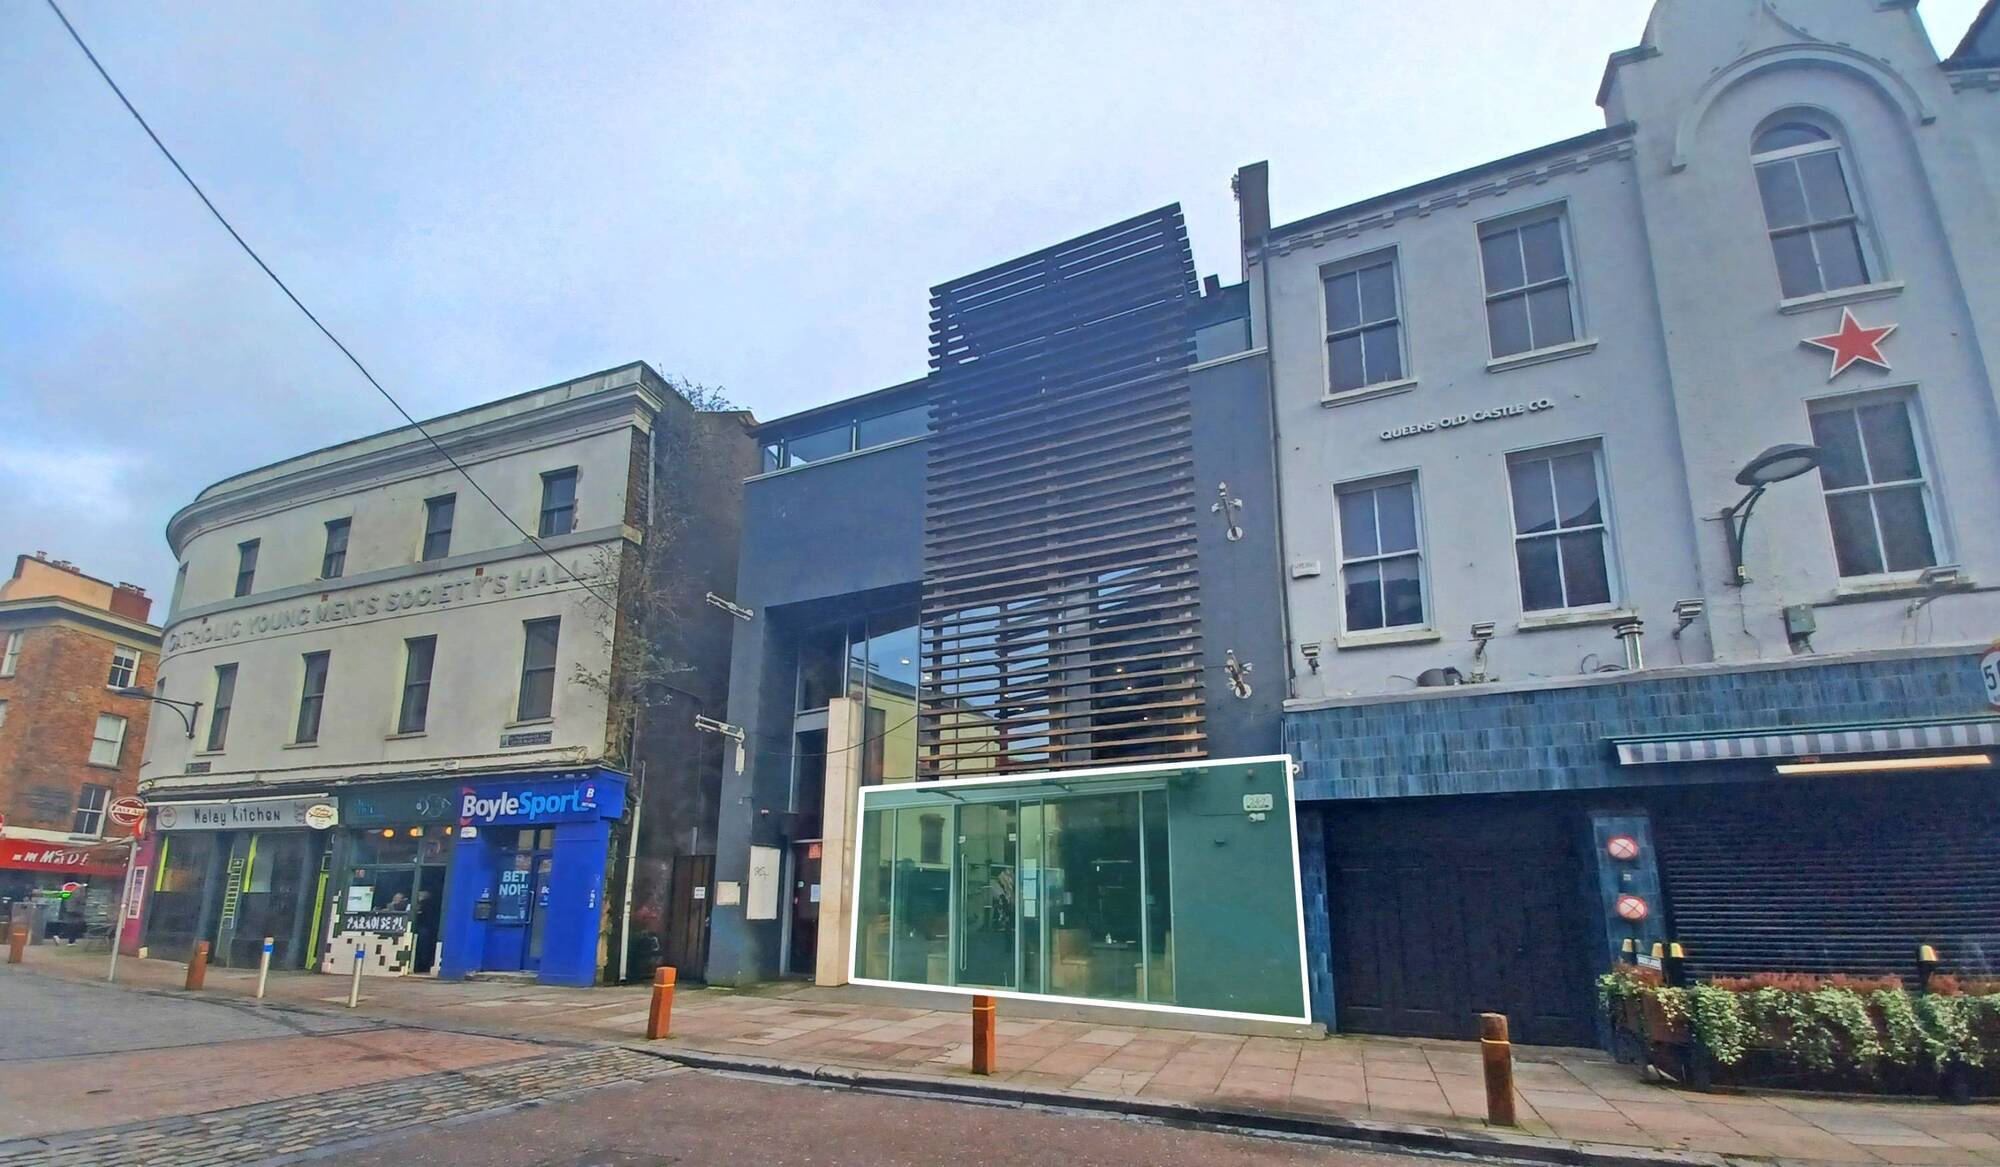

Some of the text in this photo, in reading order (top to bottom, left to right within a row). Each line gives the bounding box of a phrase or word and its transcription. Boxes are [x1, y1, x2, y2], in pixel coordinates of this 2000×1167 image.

[1380, 398, 1556, 441] QUEENS OLD CASTLE CO.
[169, 620, 242, 652] CATHOLIC
[249, 607, 311, 635] YOUNG
[514, 560, 599, 592] HALL
[194, 808, 227, 826] Malay
[232, 805, 281, 822] Kitchen
[502, 870, 529, 882] BET
[498, 883, 529, 896] NOW
